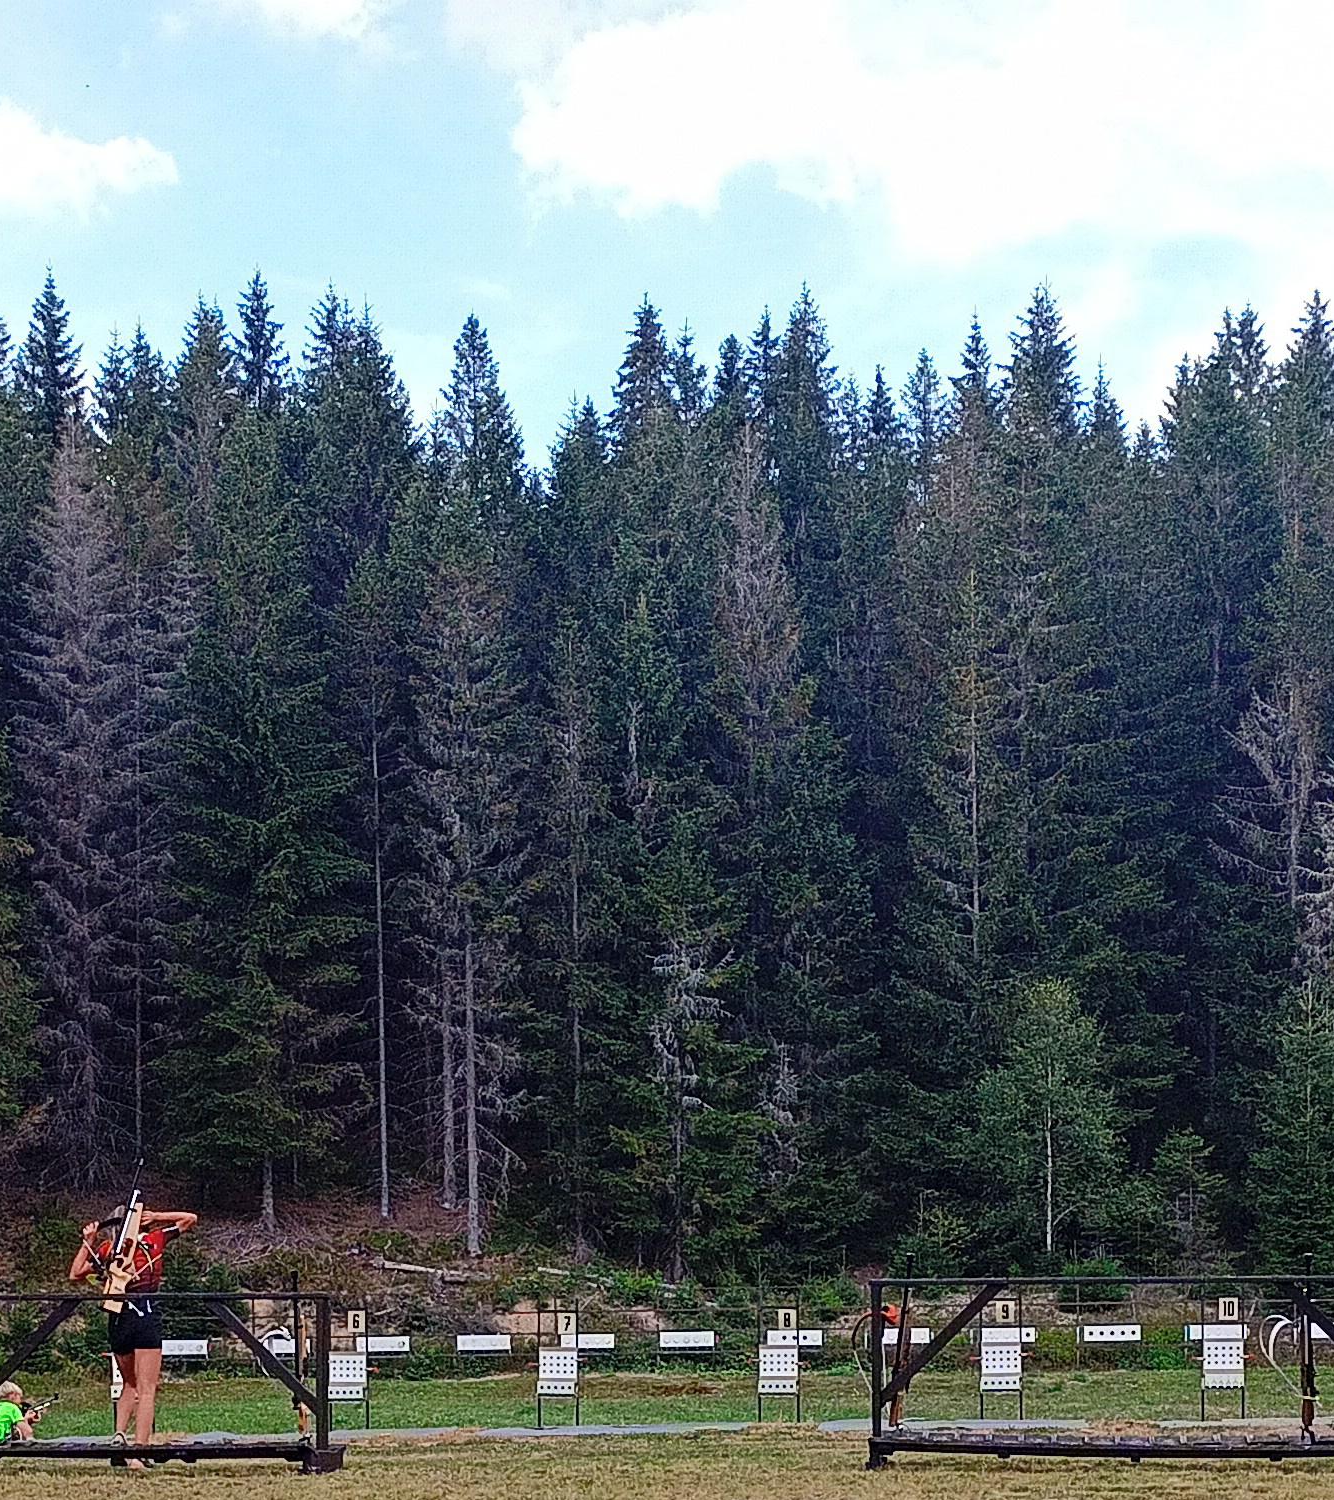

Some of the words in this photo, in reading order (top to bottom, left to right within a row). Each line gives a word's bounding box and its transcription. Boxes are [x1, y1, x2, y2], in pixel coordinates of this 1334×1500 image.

[1001, 1304, 1009, 1319] 9
[1223, 1301, 1235, 1316] 10
[353, 1313, 359, 1328] 6
[564, 1315, 571, 1331] 7
[783, 1312, 791, 1327] 8
